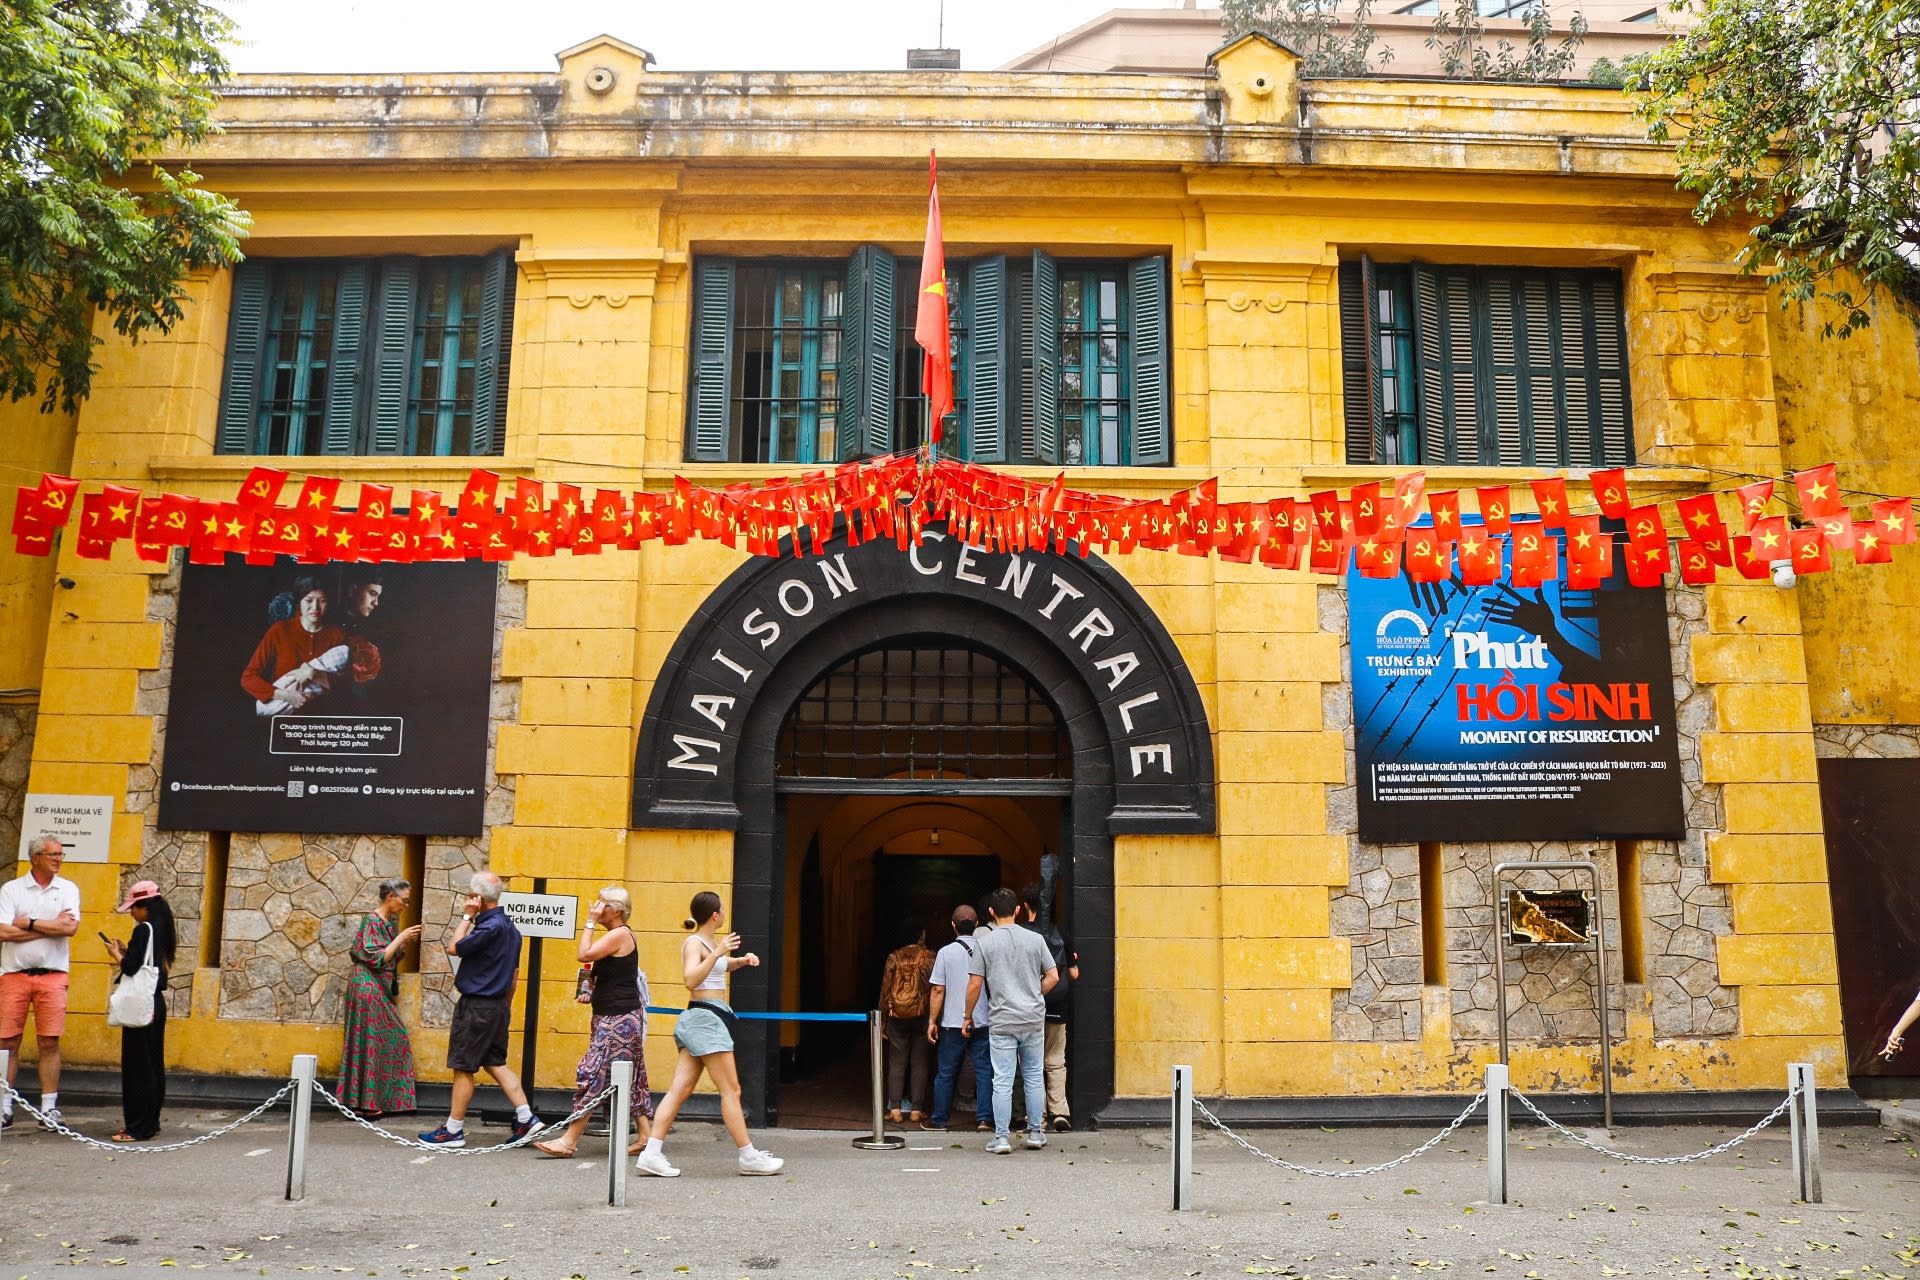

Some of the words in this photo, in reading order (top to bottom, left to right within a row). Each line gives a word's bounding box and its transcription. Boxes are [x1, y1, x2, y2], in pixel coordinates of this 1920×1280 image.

[666, 552, 859, 777] MAISON
[910, 531, 1173, 777] CENTRALE
[1366, 655, 1413, 667] TRƯNG
[1417, 654, 1442, 667] BÀY
[1378, 668, 1432, 676] EXHIBITION
[1455, 669, 1541, 722] HỒI
[1548, 681, 1653, 722] SINH
[1459, 730, 1528, 745] MOMENT
[1528, 730, 1549, 744] OF
[1630, 761, 1646, 770] (1973
[1650, 761, 1666, 770] 2023)
[34, 806, 48, 814] XẾP
[51, 807, 72, 815] HÀNG
[93, 807, 102, 816] VÉ
[507, 904, 526, 913] NƠI
[528, 904, 550, 914] BÁN
[552, 905, 565, 915] VÉ
[536, 917, 564, 927] Office
